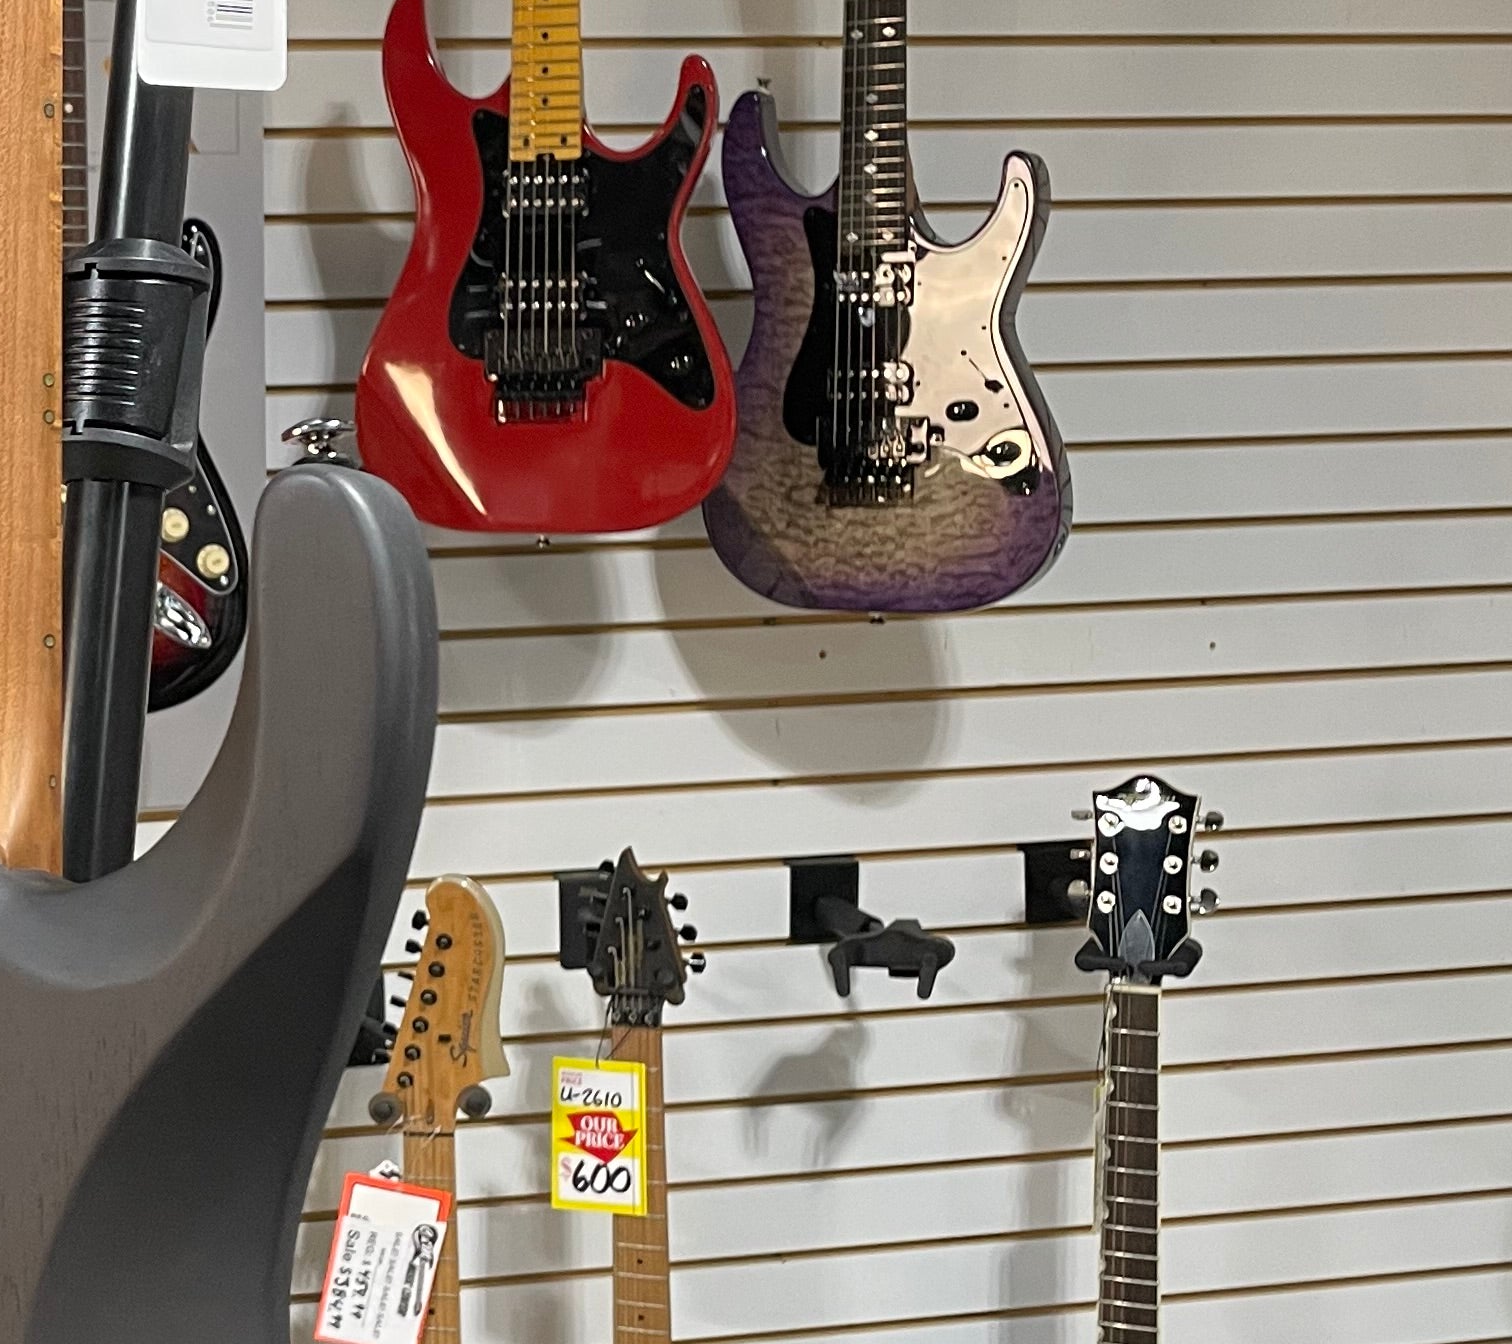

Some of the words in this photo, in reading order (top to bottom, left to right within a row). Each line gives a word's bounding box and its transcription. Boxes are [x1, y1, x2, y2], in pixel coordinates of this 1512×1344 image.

[560, 1086, 623, 1108] U-2610
[580, 1115, 619, 1133] OUR
[575, 1130, 625, 1150] PRICE
[343, 1229, 361, 1263] Sale
